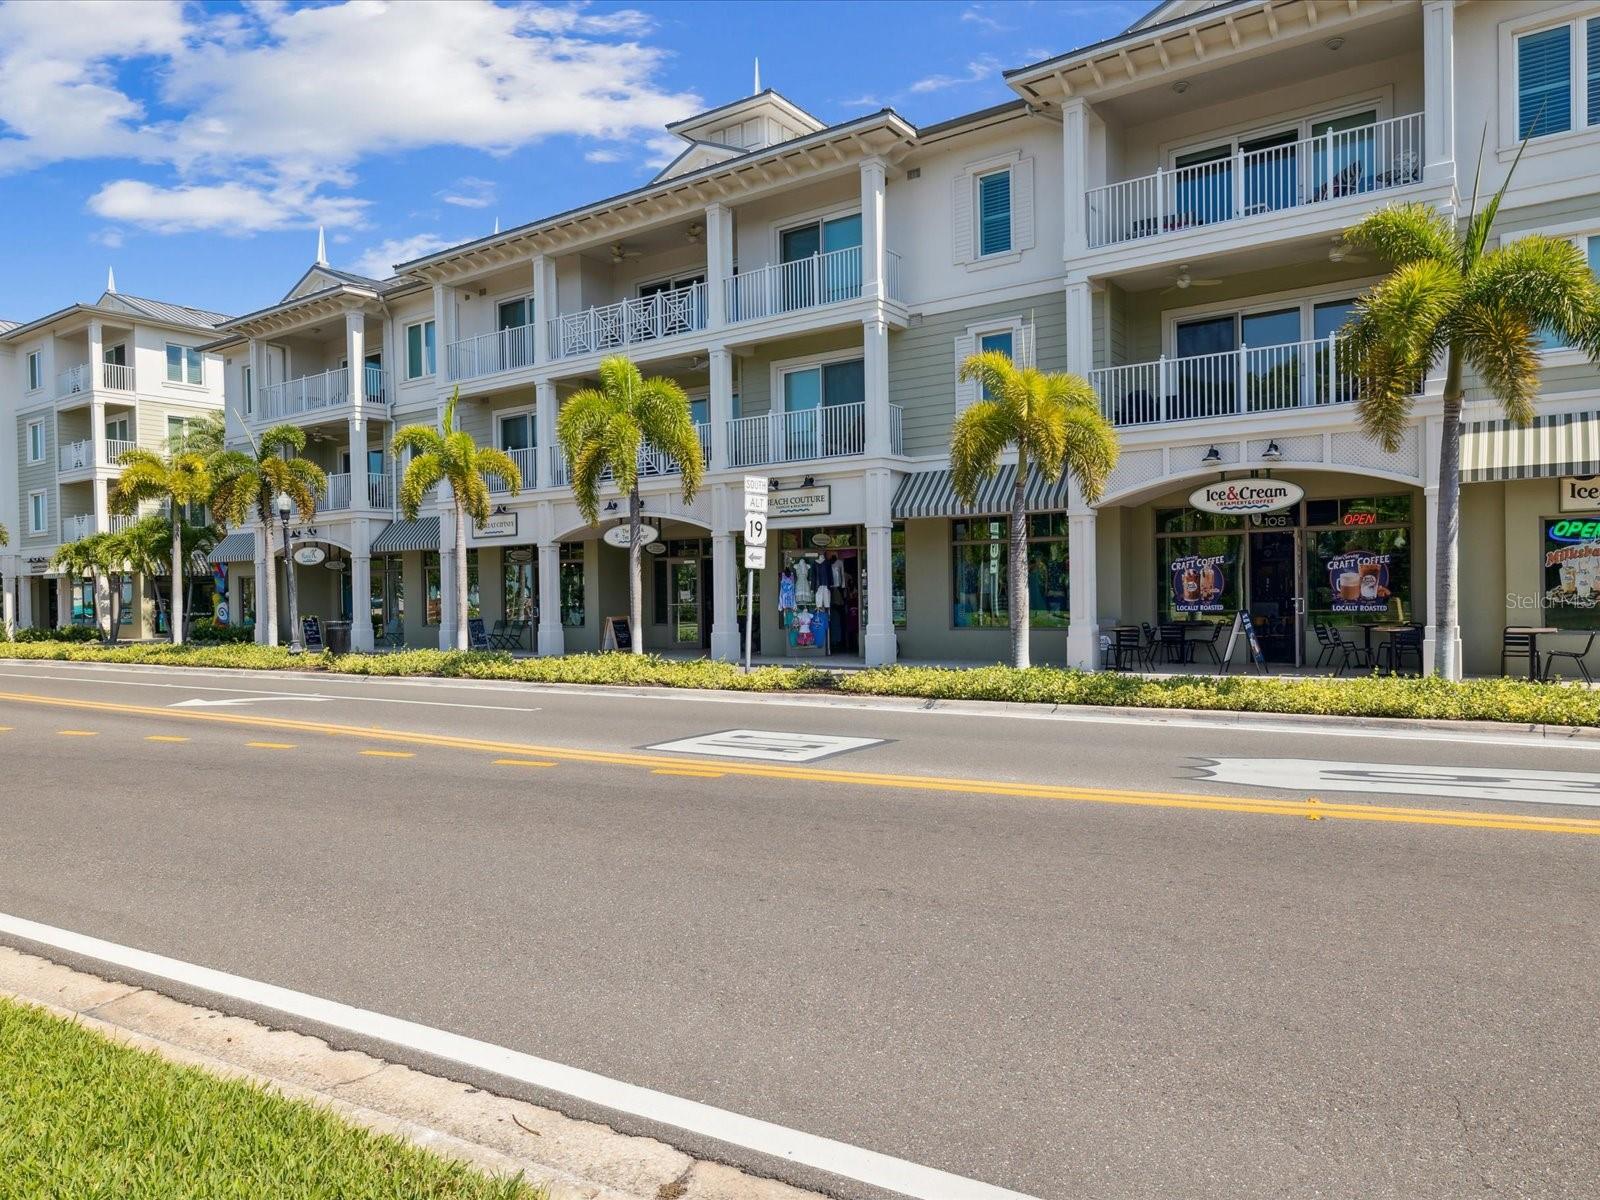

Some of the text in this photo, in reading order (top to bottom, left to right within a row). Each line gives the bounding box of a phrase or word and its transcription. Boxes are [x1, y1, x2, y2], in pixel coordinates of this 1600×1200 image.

[746, 480, 768, 490] SOUTH
[750, 498, 764, 508] ALT
[790, 495, 825, 504] COUTURE
[1265, 516, 1287, 526] 108
[1343, 513, 1376, 526] OPEN
[750, 520, 763, 538] 19
[1171, 560, 1195, 571] CRAFT
[1196, 555, 1225, 567] COFFEE
[1327, 554, 1390, 570] CRAFT COFFEE
[1332, 604, 1388, 612] LOCALLY ROASTED
